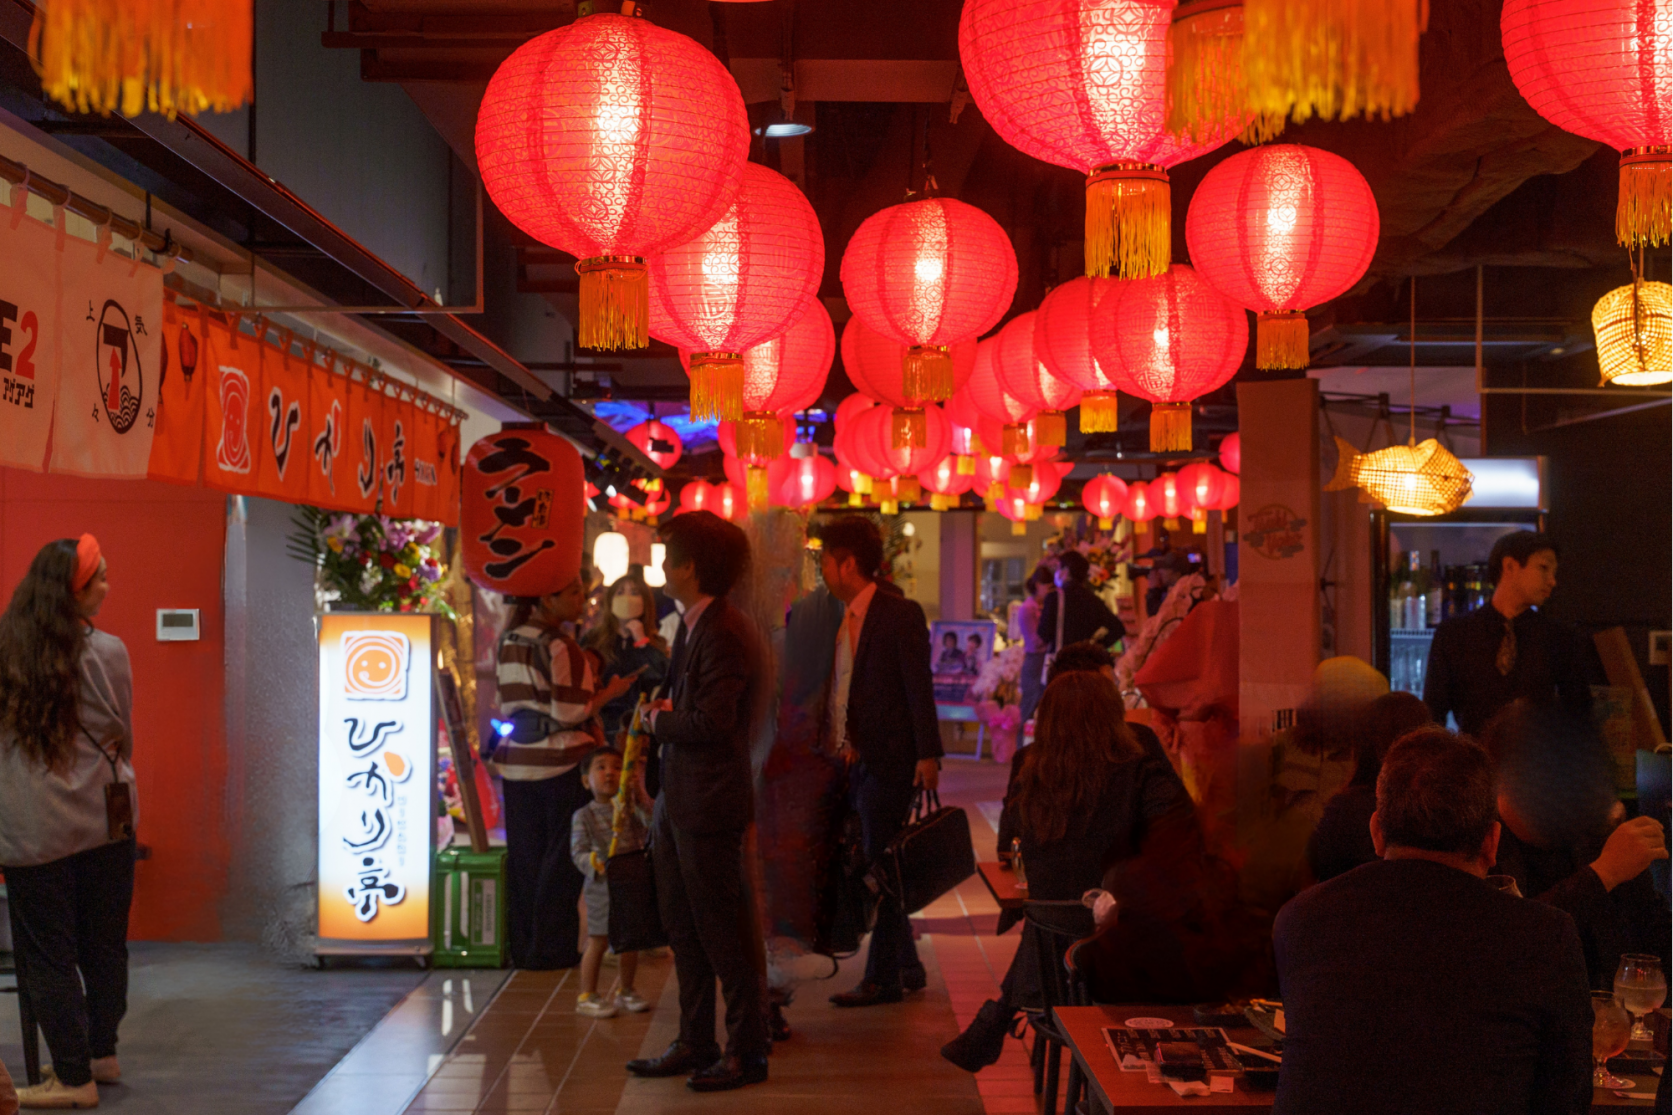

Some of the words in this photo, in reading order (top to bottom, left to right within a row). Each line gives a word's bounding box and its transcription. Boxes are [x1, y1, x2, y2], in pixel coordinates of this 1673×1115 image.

[86, 300, 95, 322] 上
[135, 314, 148, 336] 気
[3, 377, 35, 409] アゲアゲ
[477, 437, 555, 579] ラーメン
[344, 717, 406, 918] ひかり亭
